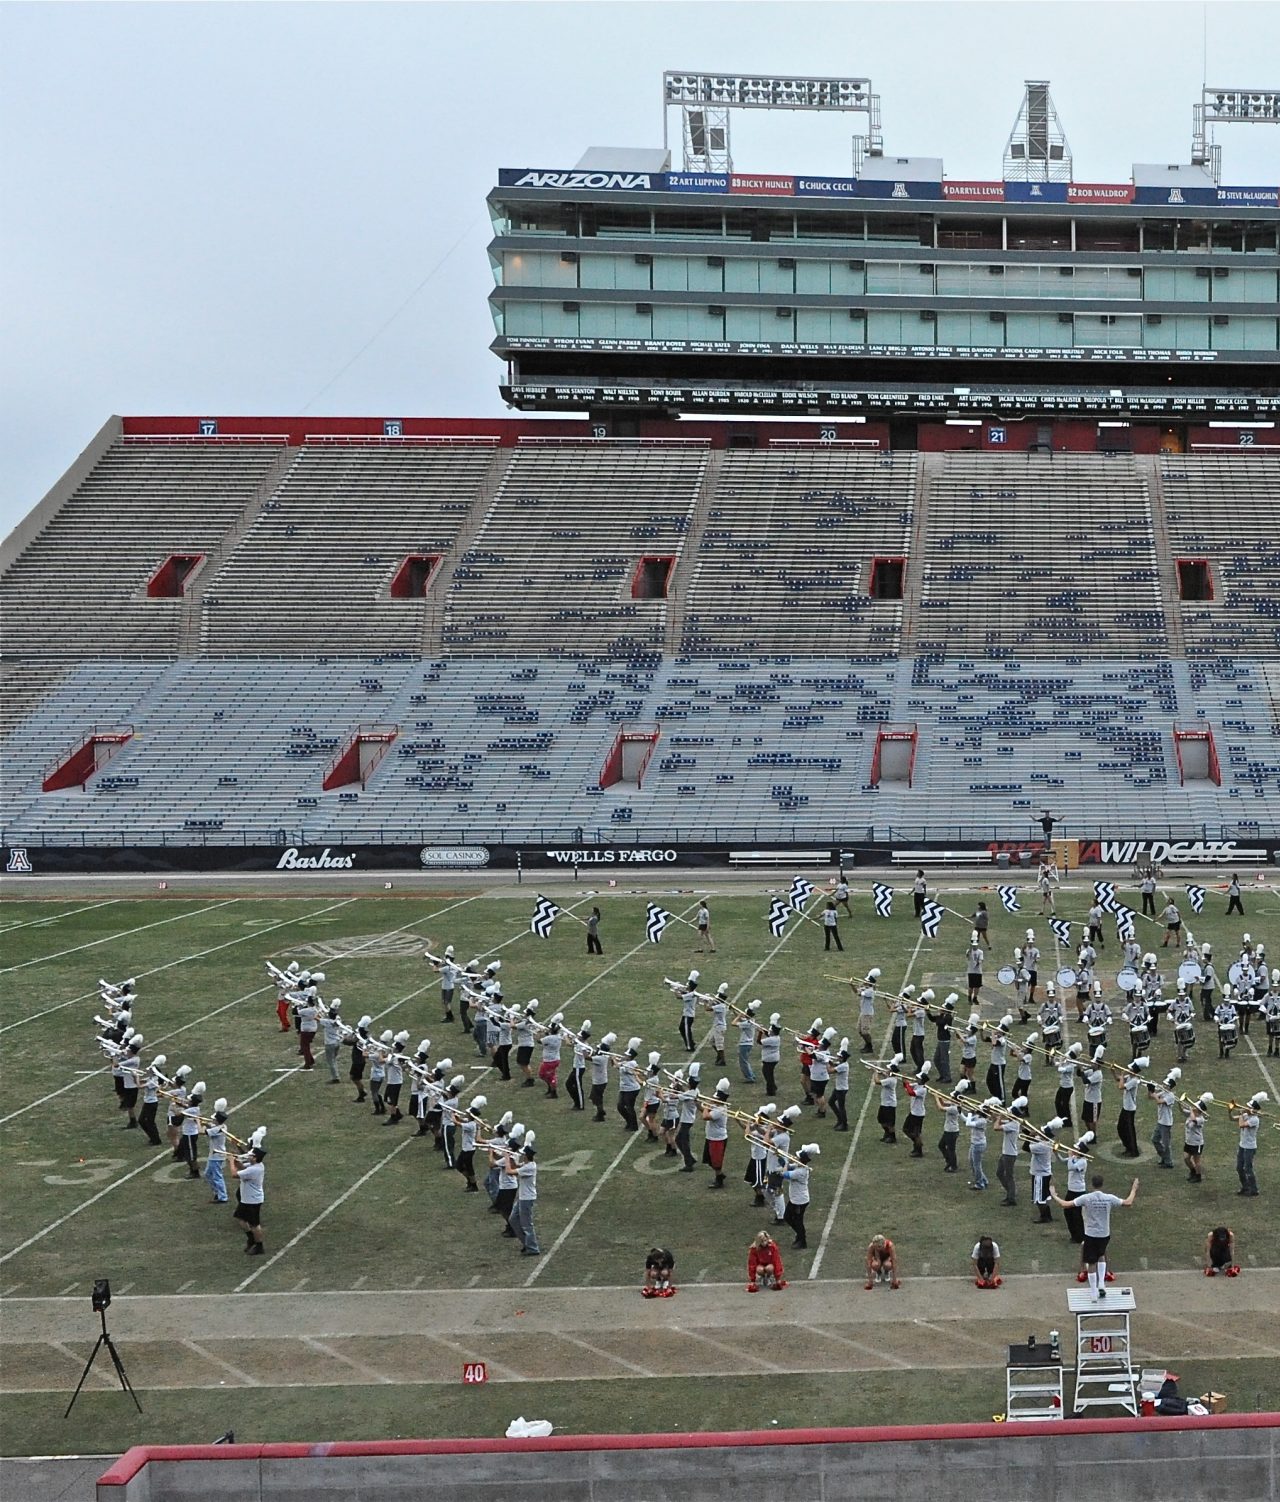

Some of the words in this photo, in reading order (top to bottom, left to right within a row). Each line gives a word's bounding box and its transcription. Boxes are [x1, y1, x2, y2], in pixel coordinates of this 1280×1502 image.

[514, 172, 651, 189] ARIZONA
[669, 176, 678, 185] 22
[695, 179, 727, 187] LUPPINO
[742, 180, 764, 188] RICKY
[765, 181, 793, 189] HUNLEY
[799, 181, 805, 189] 6
[805, 182, 831, 190] CHUCK
[832, 183, 854, 191] CECIL
[943, 186, 949, 194] 4
[982, 187, 1004, 195] LEWIS
[1068, 188, 1077, 196] 92
[1078, 189, 1093, 197] ROB
[1094, 190, 1129, 198] WALDROP
[1243, 192, 1279, 200] McLAUGHLIN
[202, 425, 215, 434] 17
[386, 426, 400, 435] 18
[593, 428, 607, 438] 19
[820, 430, 836, 440] 20
[991, 432, 1004, 442] 21
[1240, 436, 1254, 445] 22
[554, 851, 615, 862] WELLS
[618, 850, 678, 862] FARGO
[1101, 841, 1237, 863] WILDCATS
[275, 848, 356, 869] Bashas'
[537, 1149, 699, 1175] 40
[1093, 1337, 1111, 1352] 50
[465, 1364, 484, 1383] 40
